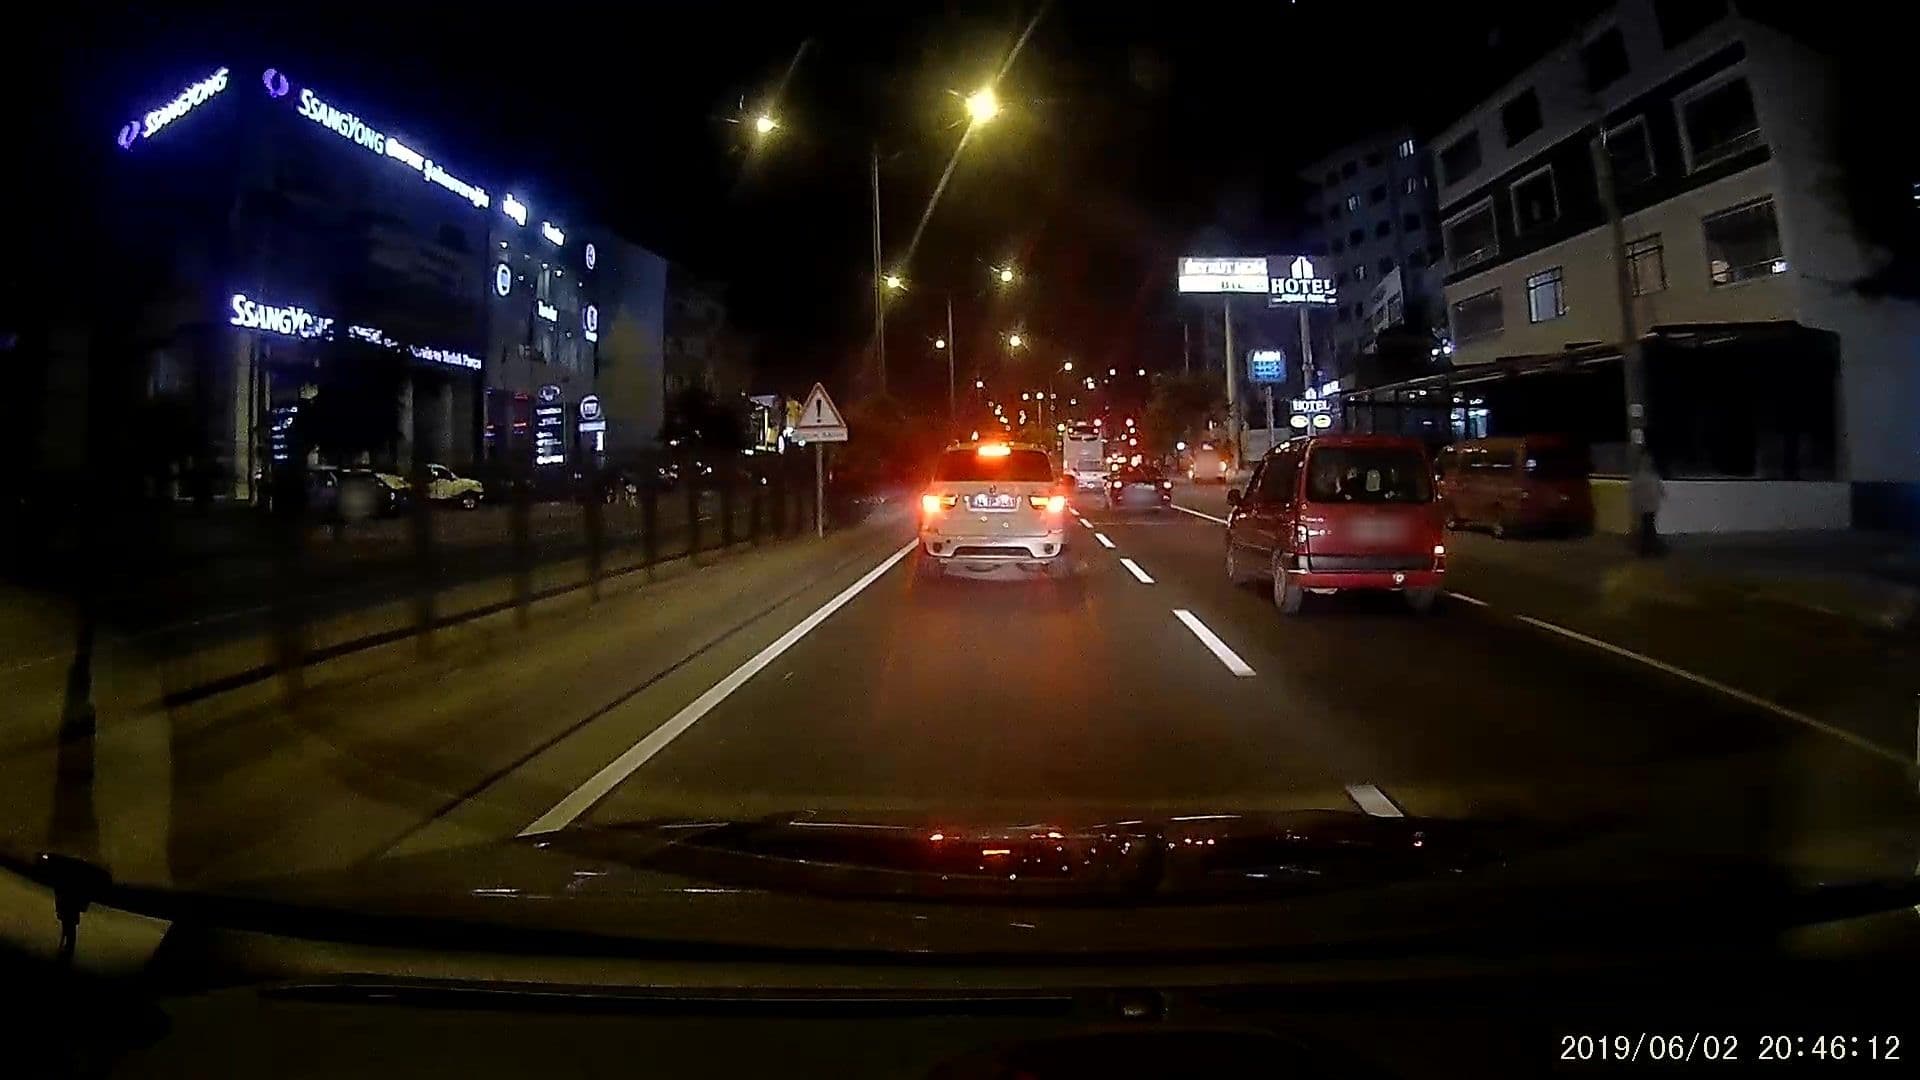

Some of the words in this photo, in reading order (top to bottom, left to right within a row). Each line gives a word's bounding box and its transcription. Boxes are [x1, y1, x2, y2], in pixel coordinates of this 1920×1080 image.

[298, 88, 385, 155] SSANGYONG
[1271, 278, 1337, 295] HOTEL
[1292, 399, 1331, 413] HOTEL
